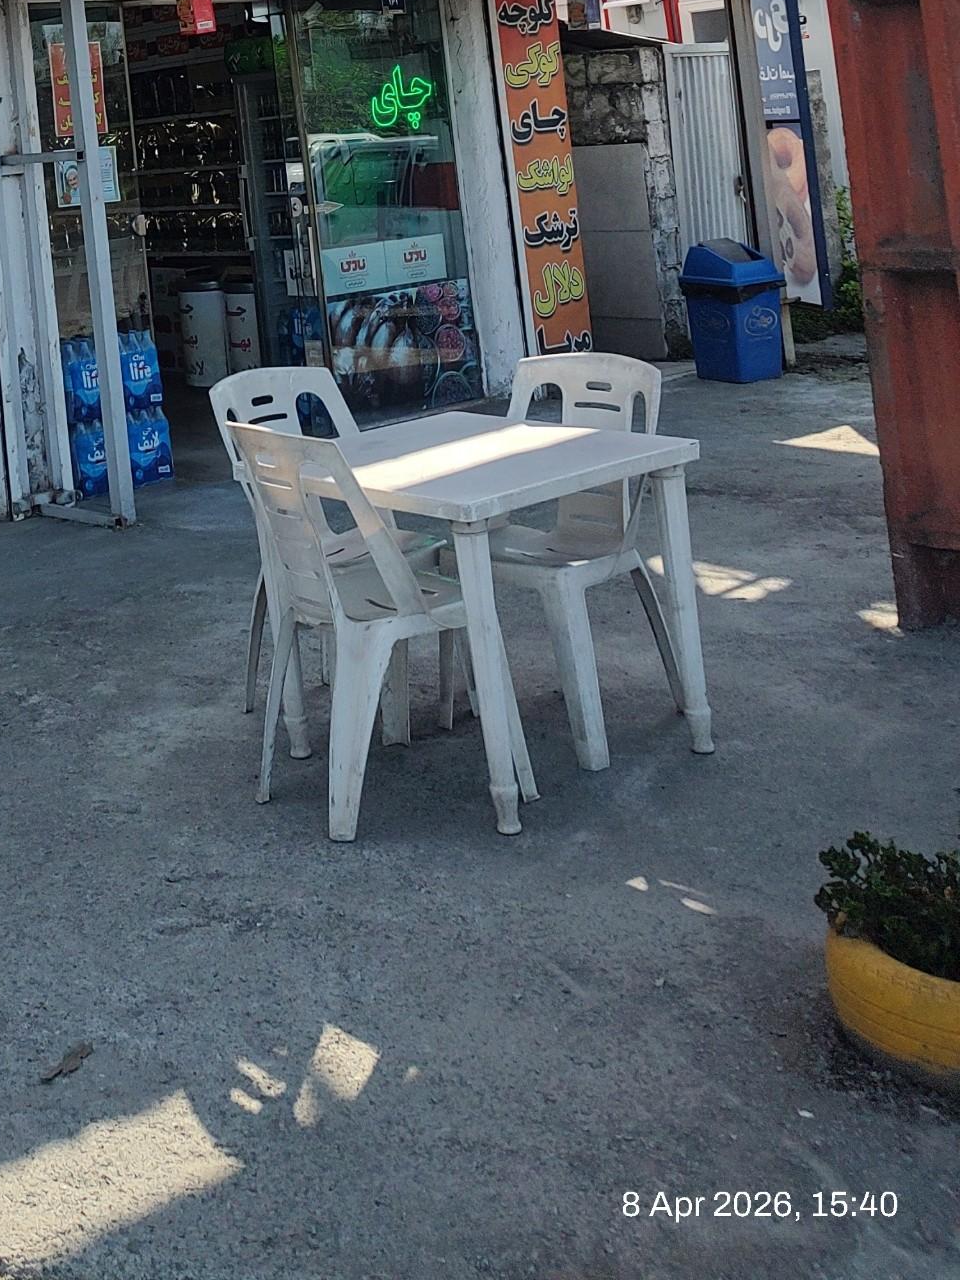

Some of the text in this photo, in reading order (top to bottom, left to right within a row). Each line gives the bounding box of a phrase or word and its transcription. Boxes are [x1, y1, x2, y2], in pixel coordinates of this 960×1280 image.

[504, 41, 560, 88] کوکی
[371, 63, 432, 130] چای
[511, 98, 567, 143] چای
[516, 154, 574, 195] لواشک
[523, 208, 580, 248] ترشک
[533, 260, 585, 317] دلال
[536, 323, 593, 356] مربا
[129, 361, 152, 381] life
